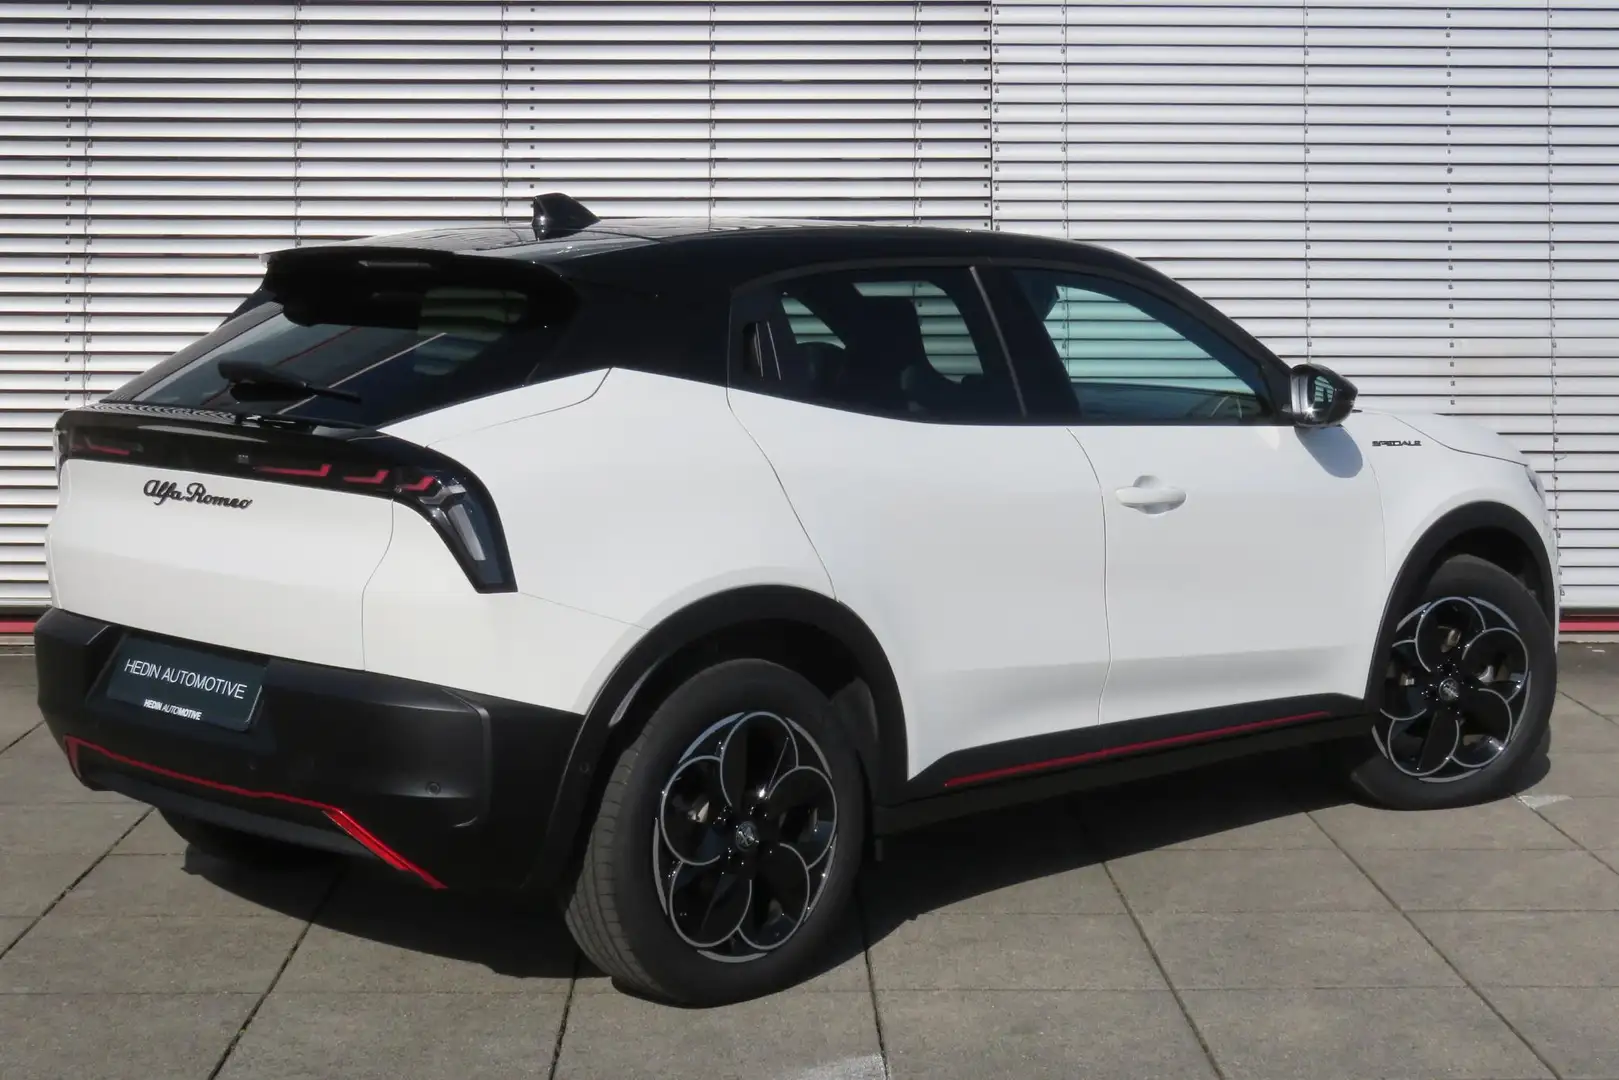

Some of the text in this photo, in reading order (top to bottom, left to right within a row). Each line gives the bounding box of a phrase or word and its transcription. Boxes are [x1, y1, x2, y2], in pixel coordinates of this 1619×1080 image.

[143, 479, 253, 510] Alfa Romeo
[124, 658, 248, 700] HEDIN AUTOMOTIVE
[143, 698, 203, 721] HEDIN AUTOMOTIVE
